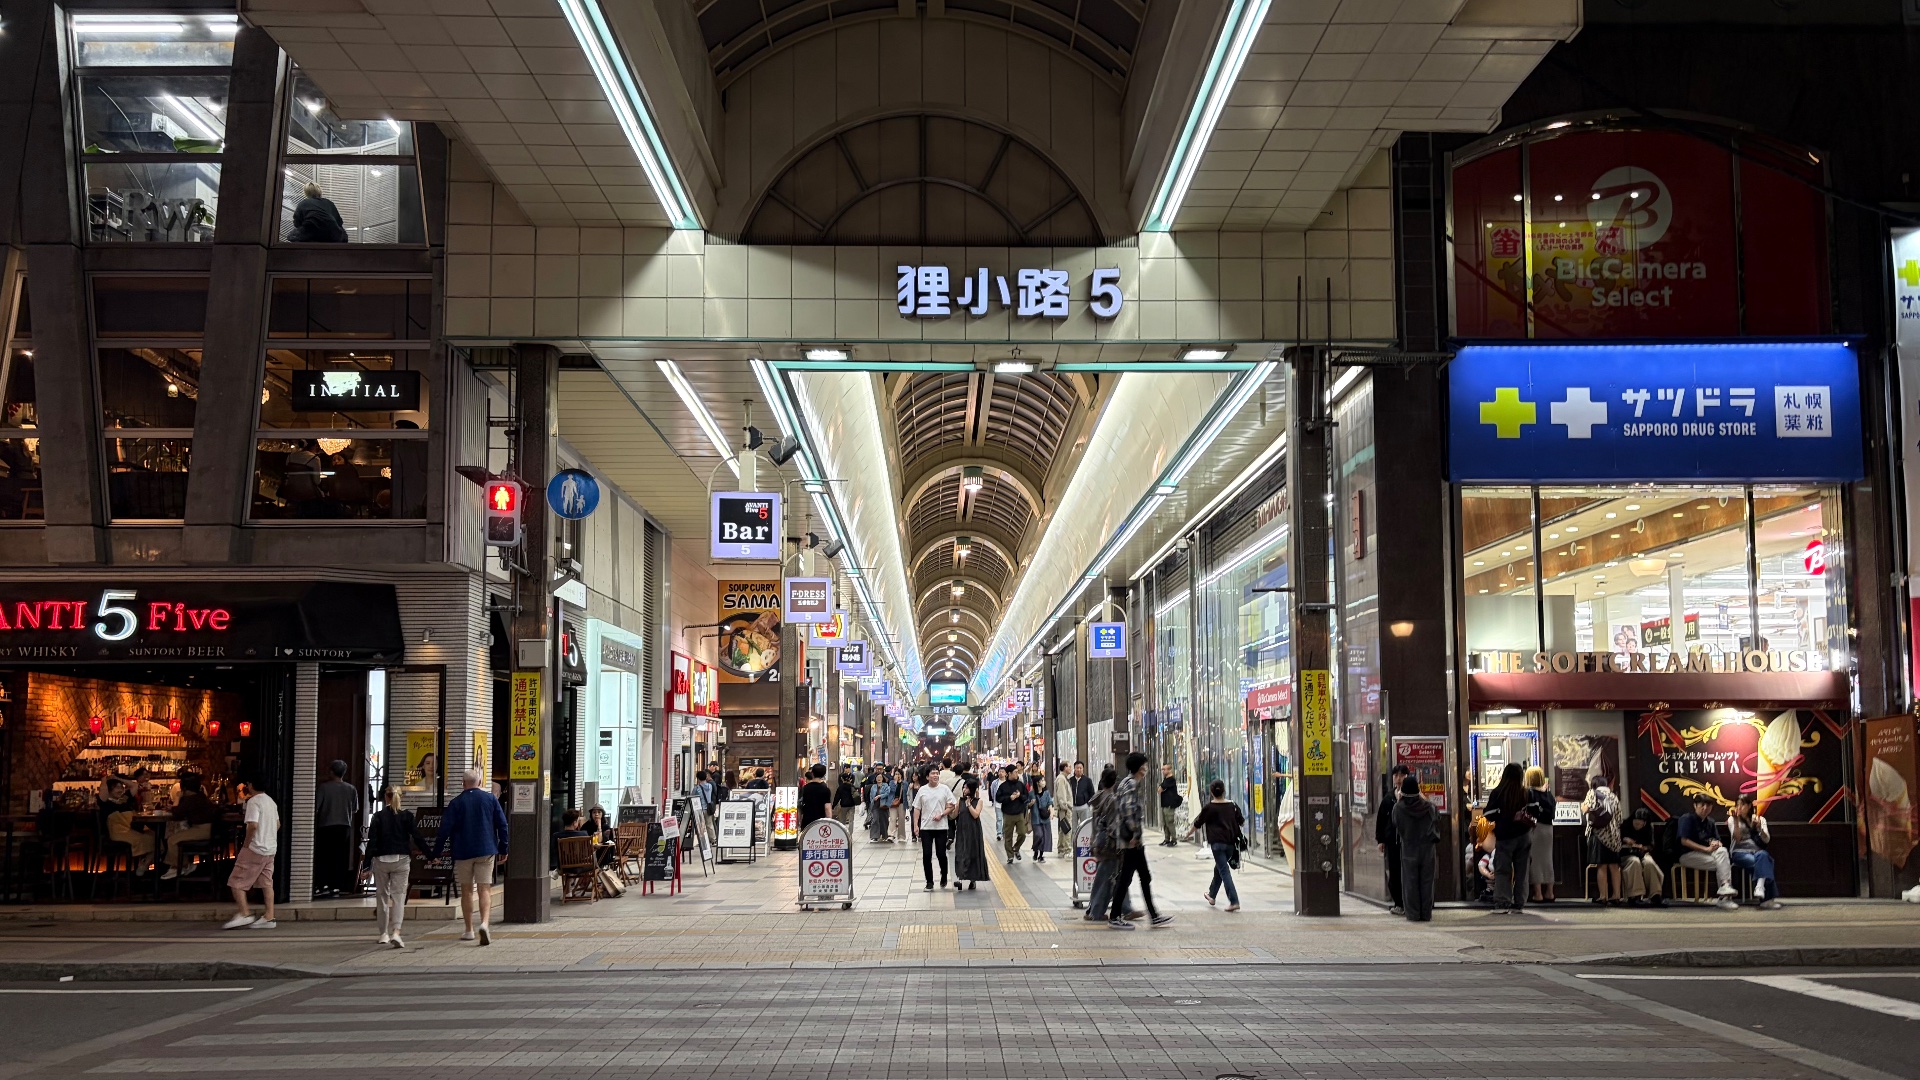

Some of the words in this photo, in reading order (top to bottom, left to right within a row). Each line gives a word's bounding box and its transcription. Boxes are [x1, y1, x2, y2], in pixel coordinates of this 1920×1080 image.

[1556, 258, 1707, 280] BicCamera
[897, 265, 1070, 318] 狸小路
[1089, 267, 1124, 318] 5
[1592, 285, 1673, 307] Select
[309, 384, 400, 397] INTIAL
[1622, 387, 1756, 418] サツドラ
[1783, 392, 1823, 410] 札幌
[1623, 422, 1678, 437] SAPPORO
[1682, 422, 1715, 437] DRUG
[1719, 422, 1757, 436] STORE
[1784, 414, 1824, 431] 薬粧
[758, 507, 769, 519] 5
[722, 522, 769, 540] Bar
[741, 544, 751, 555] 5
[728, 583, 748, 592] SOUP
[749, 583, 775, 592] CURRY
[723, 593, 780, 610] SAMA
[94, 588, 139, 641] 5
[148, 602, 231, 631] Five
[18, 646, 79, 657] WHISKY
[128, 647, 183, 657] SUNTORY
[187, 646, 226, 657] BEER
[298, 648, 353, 658] SUNTORY
[1477, 651, 1525, 673] THE
[1532, 651, 1712, 673] SOFTCREAM
[1724, 650, 1822, 673] HOUSE
[768, 669, 780, 682] 2
[514, 678, 527, 737] 通行禁止
[528, 678, 538, 736] 許可車両以外
[1304, 673, 1315, 738] ご通行ください
[1317, 672, 1327, 738] 自転車から降りて
[736, 729, 771, 737] 吉山商店
[805, 850, 846, 860] 歩行者専用
